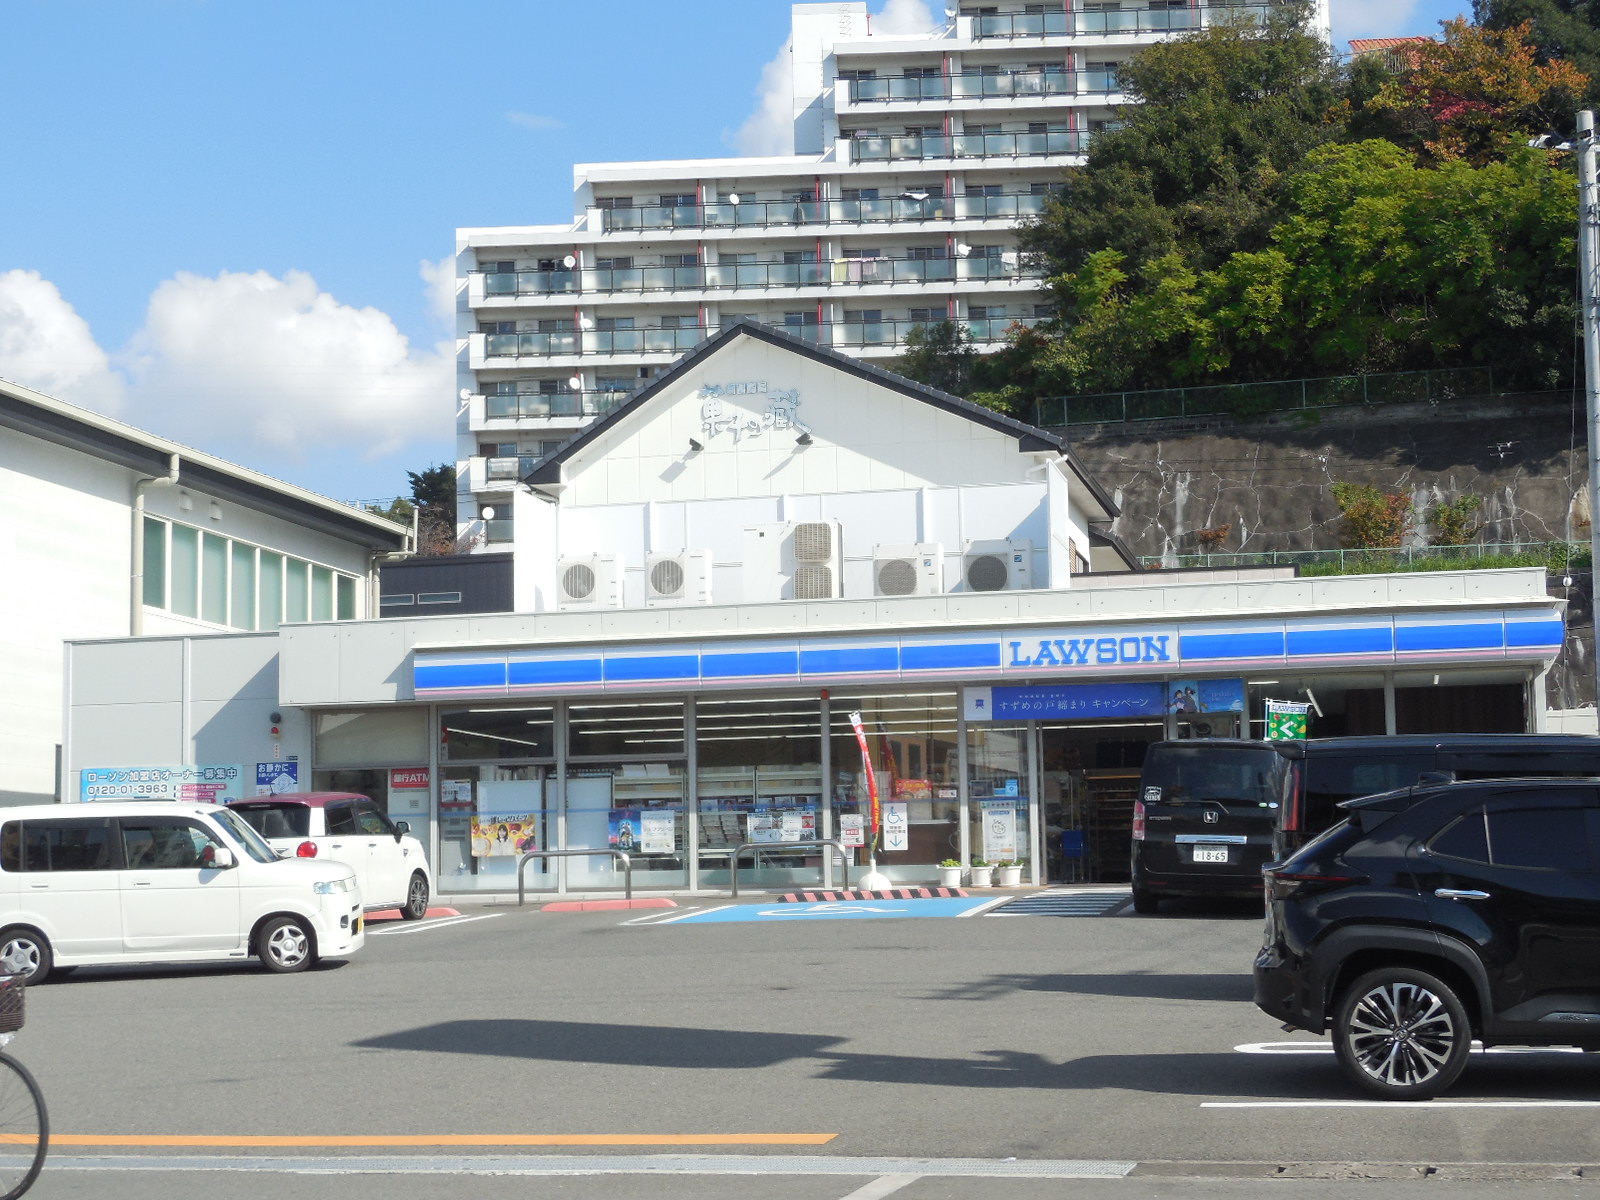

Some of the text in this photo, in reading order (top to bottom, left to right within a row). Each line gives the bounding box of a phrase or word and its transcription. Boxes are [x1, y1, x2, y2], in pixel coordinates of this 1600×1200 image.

[1009, 635, 1170, 667] LAWSON
[999, 698, 1149, 711] すずめの戸締まり キャンペーン
[1280, 720, 1295, 740] く
[87, 767, 238, 783] ローソン加盟店オーナー募集中
[87, 784, 168, 795] 0120-01-3963
